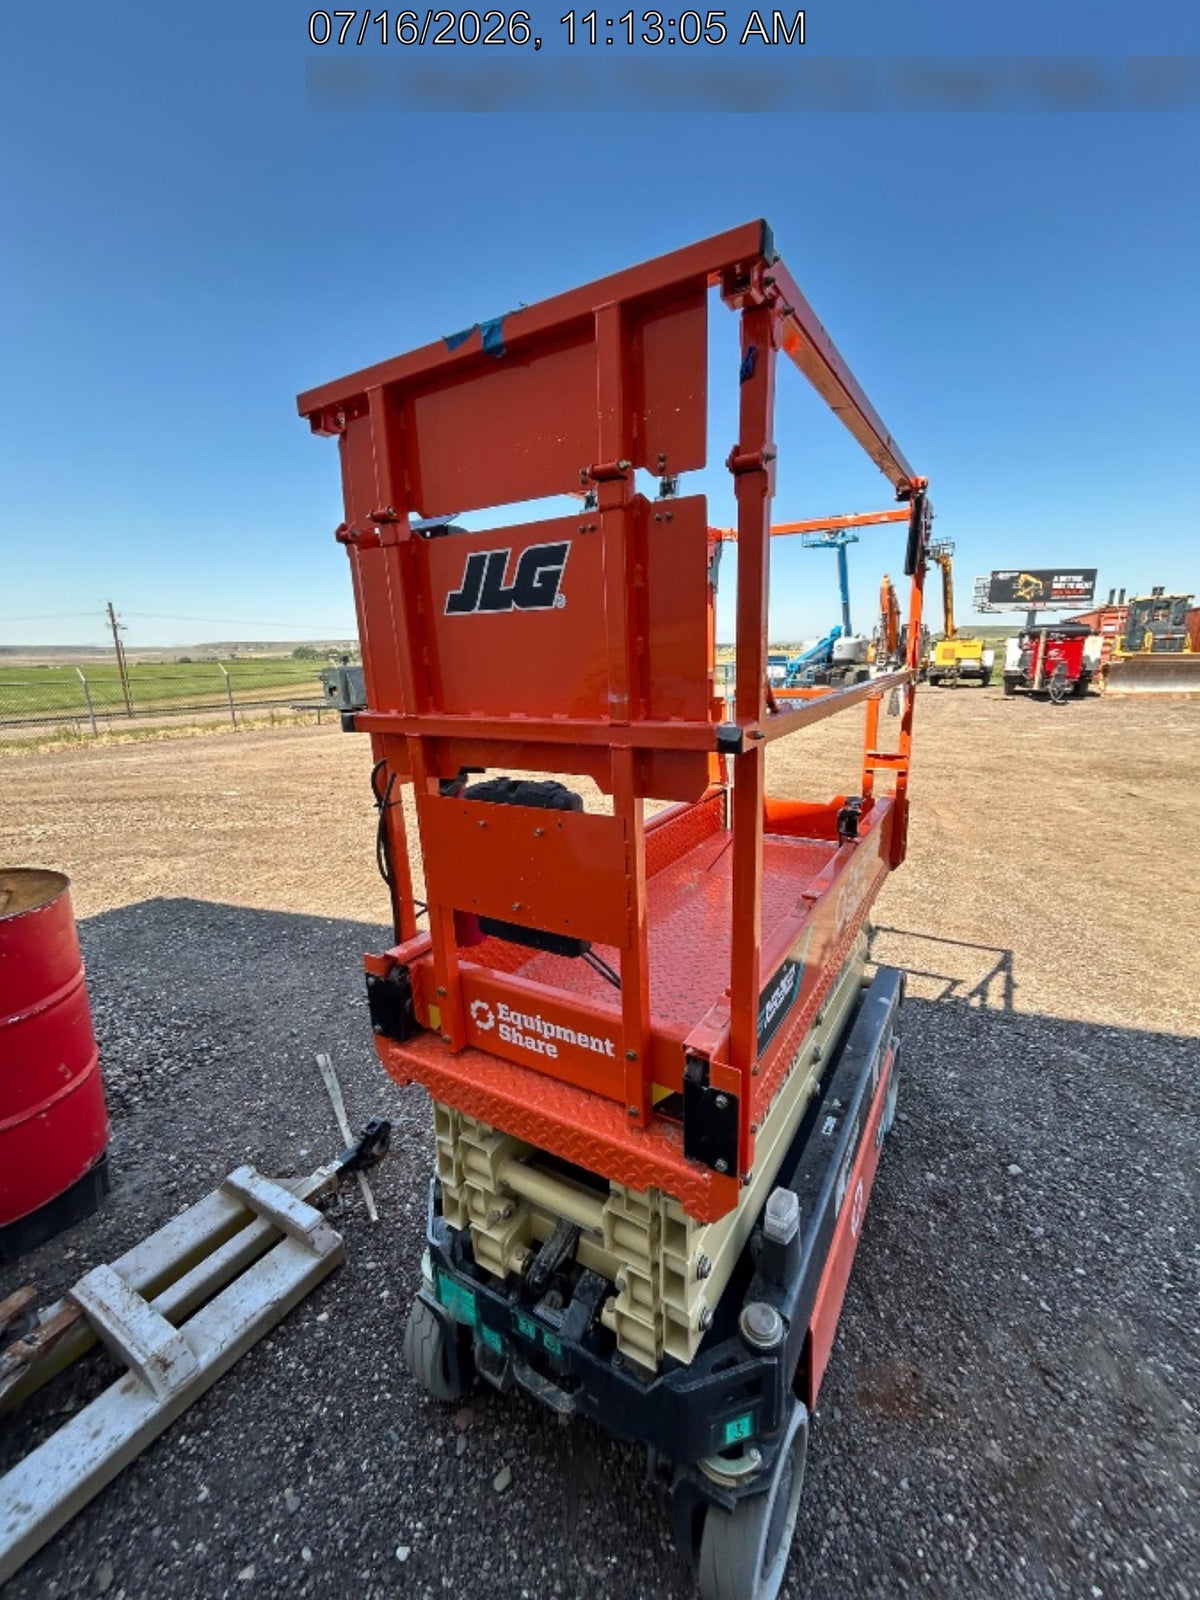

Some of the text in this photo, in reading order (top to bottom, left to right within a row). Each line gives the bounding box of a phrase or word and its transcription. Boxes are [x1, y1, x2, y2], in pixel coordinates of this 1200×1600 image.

[444, 540, 572, 615] JLG
[497, 1002, 615, 1057] Equipment
[499, 1023, 558, 1058] Share
